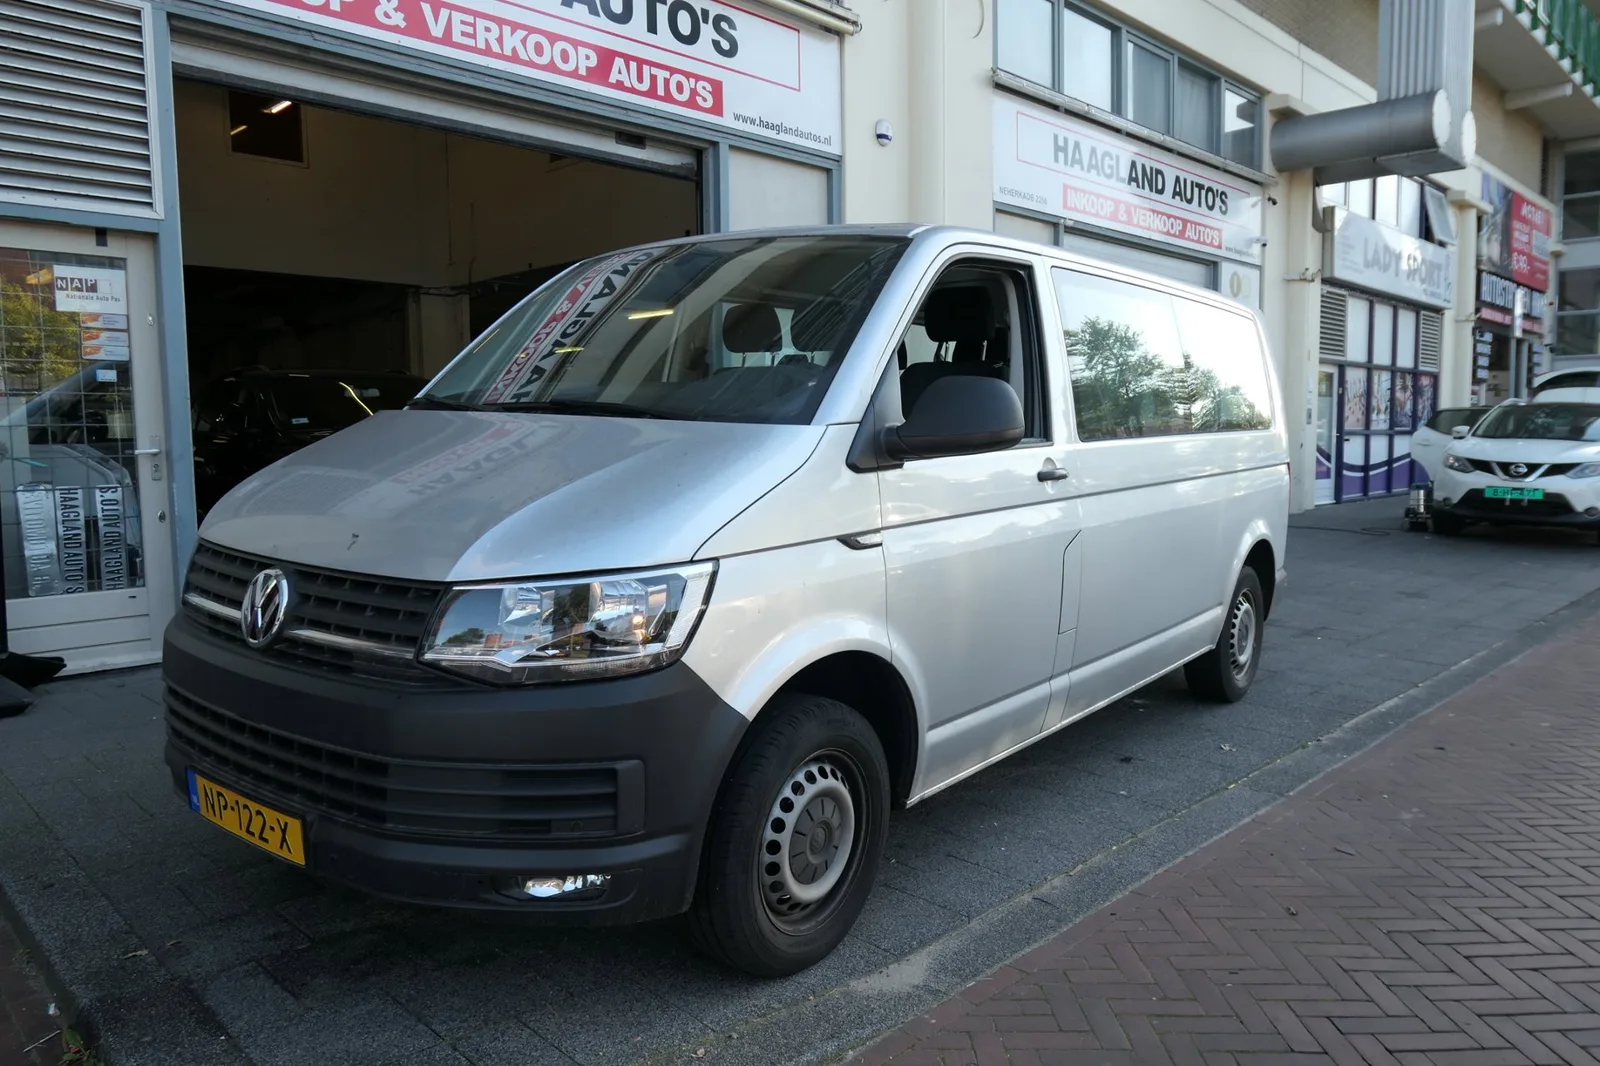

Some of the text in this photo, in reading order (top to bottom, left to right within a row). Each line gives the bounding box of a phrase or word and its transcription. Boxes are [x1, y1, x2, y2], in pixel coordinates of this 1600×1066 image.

[374, 0, 714, 109] & VERKOOP AUTO'S
[733, 112, 832, 146] www.haaglandautos.nl
[1053, 132, 1228, 216] HAAGLAND AUTO'S
[1067, 188, 1220, 246] INKOOP & VERKOOP AUTO'S
[1363, 236, 1402, 278] LADY
[1407, 252, 1442, 289] SPORT
[59, 487, 85, 594] HAAGLAND AUTO'S
[99, 486, 125, 590] HAAGLAND AUTO'S
[203, 783, 293, 855] NP-122-X
